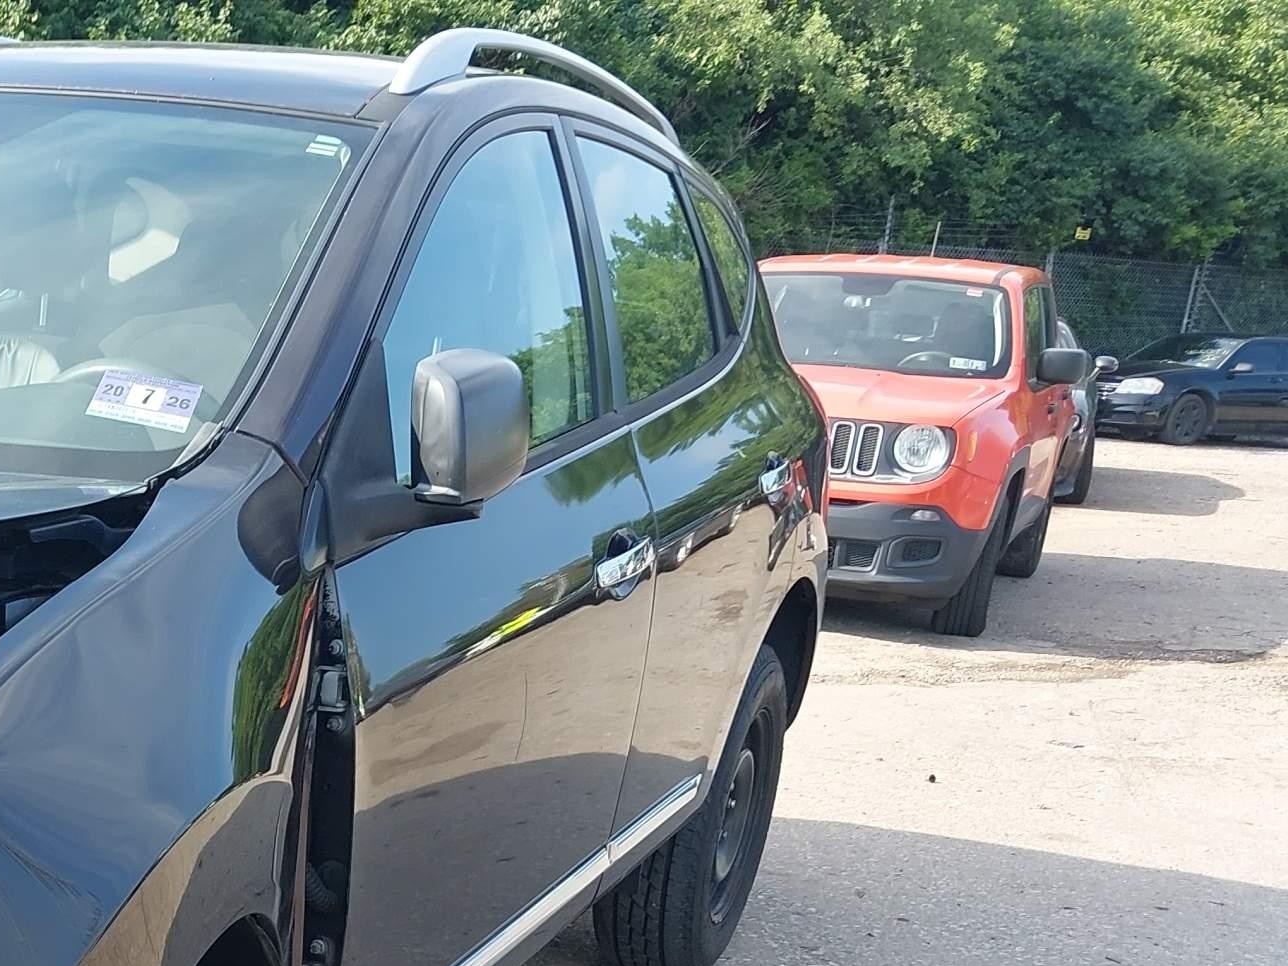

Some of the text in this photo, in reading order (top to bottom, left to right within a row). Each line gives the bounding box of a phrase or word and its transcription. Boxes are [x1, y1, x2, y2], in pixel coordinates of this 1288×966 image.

[102, 383, 191, 410] 20 7 26
